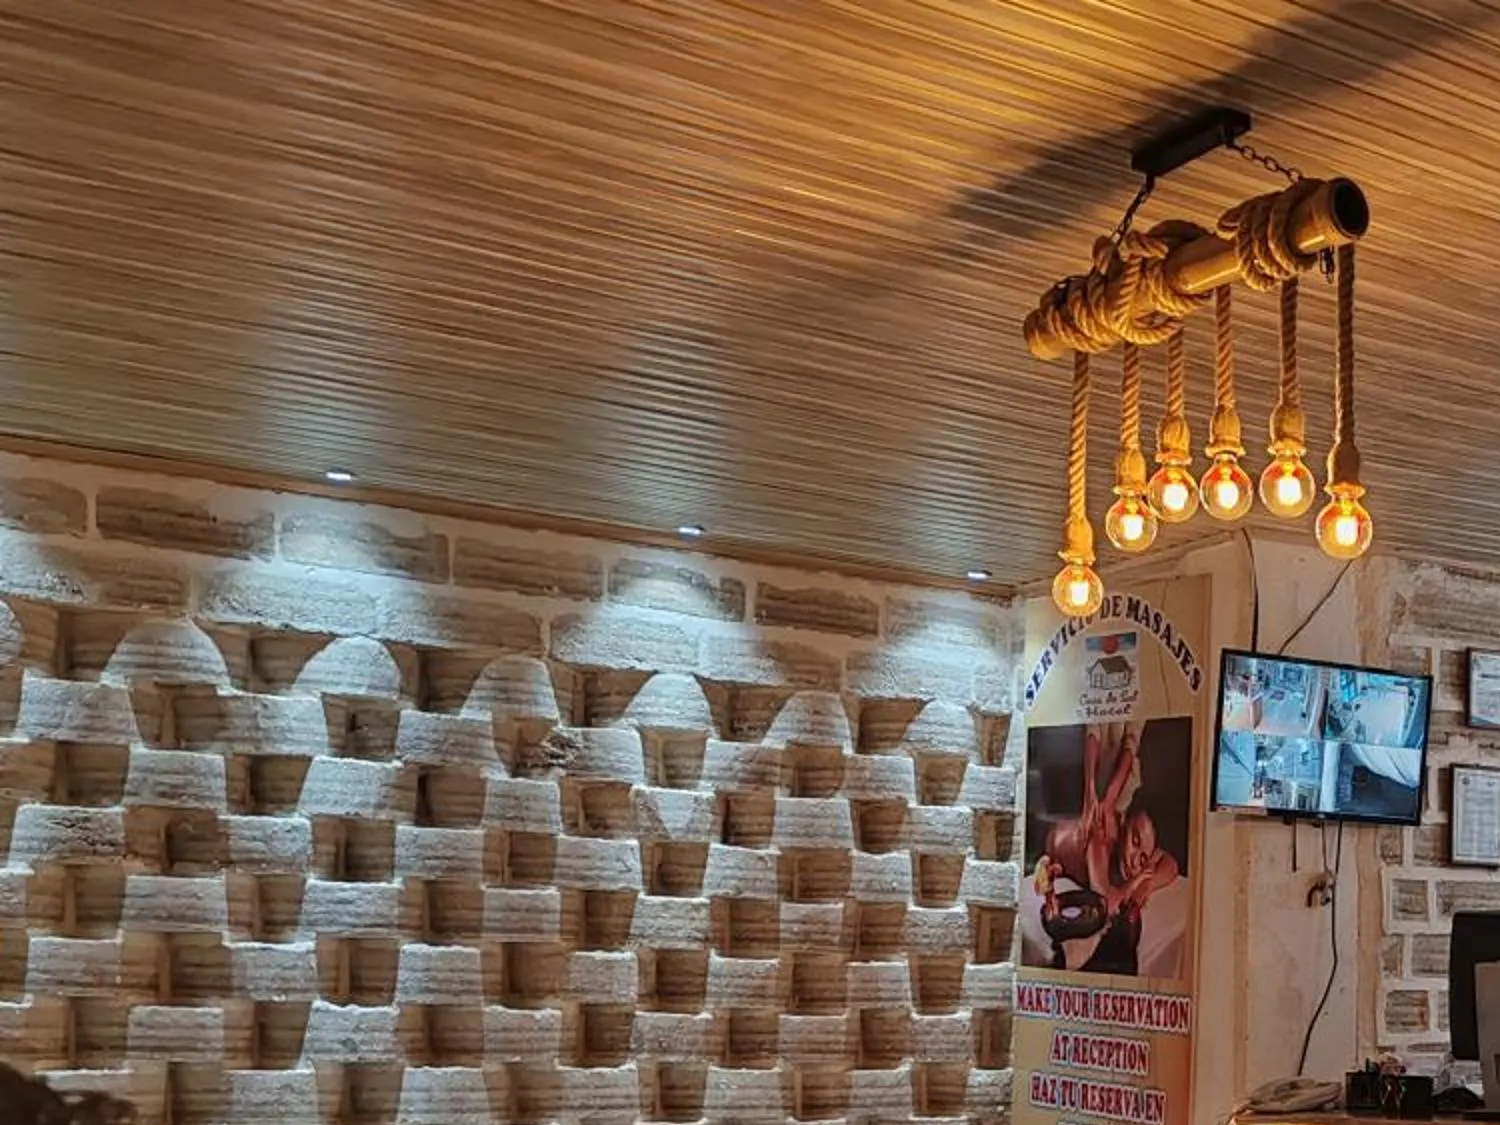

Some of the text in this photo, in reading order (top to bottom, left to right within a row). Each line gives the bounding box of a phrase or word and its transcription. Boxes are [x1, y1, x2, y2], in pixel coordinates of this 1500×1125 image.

[1101, 594, 1121, 620] DE
[1127, 597, 1202, 692] MASAJES
[1017, 985, 1189, 1030] MAKE YOUR RESERVATION
[1052, 1036, 1147, 1072] AT RECEPTION
[1031, 1075, 1164, 1123] HAZ TU RESERVA EN
